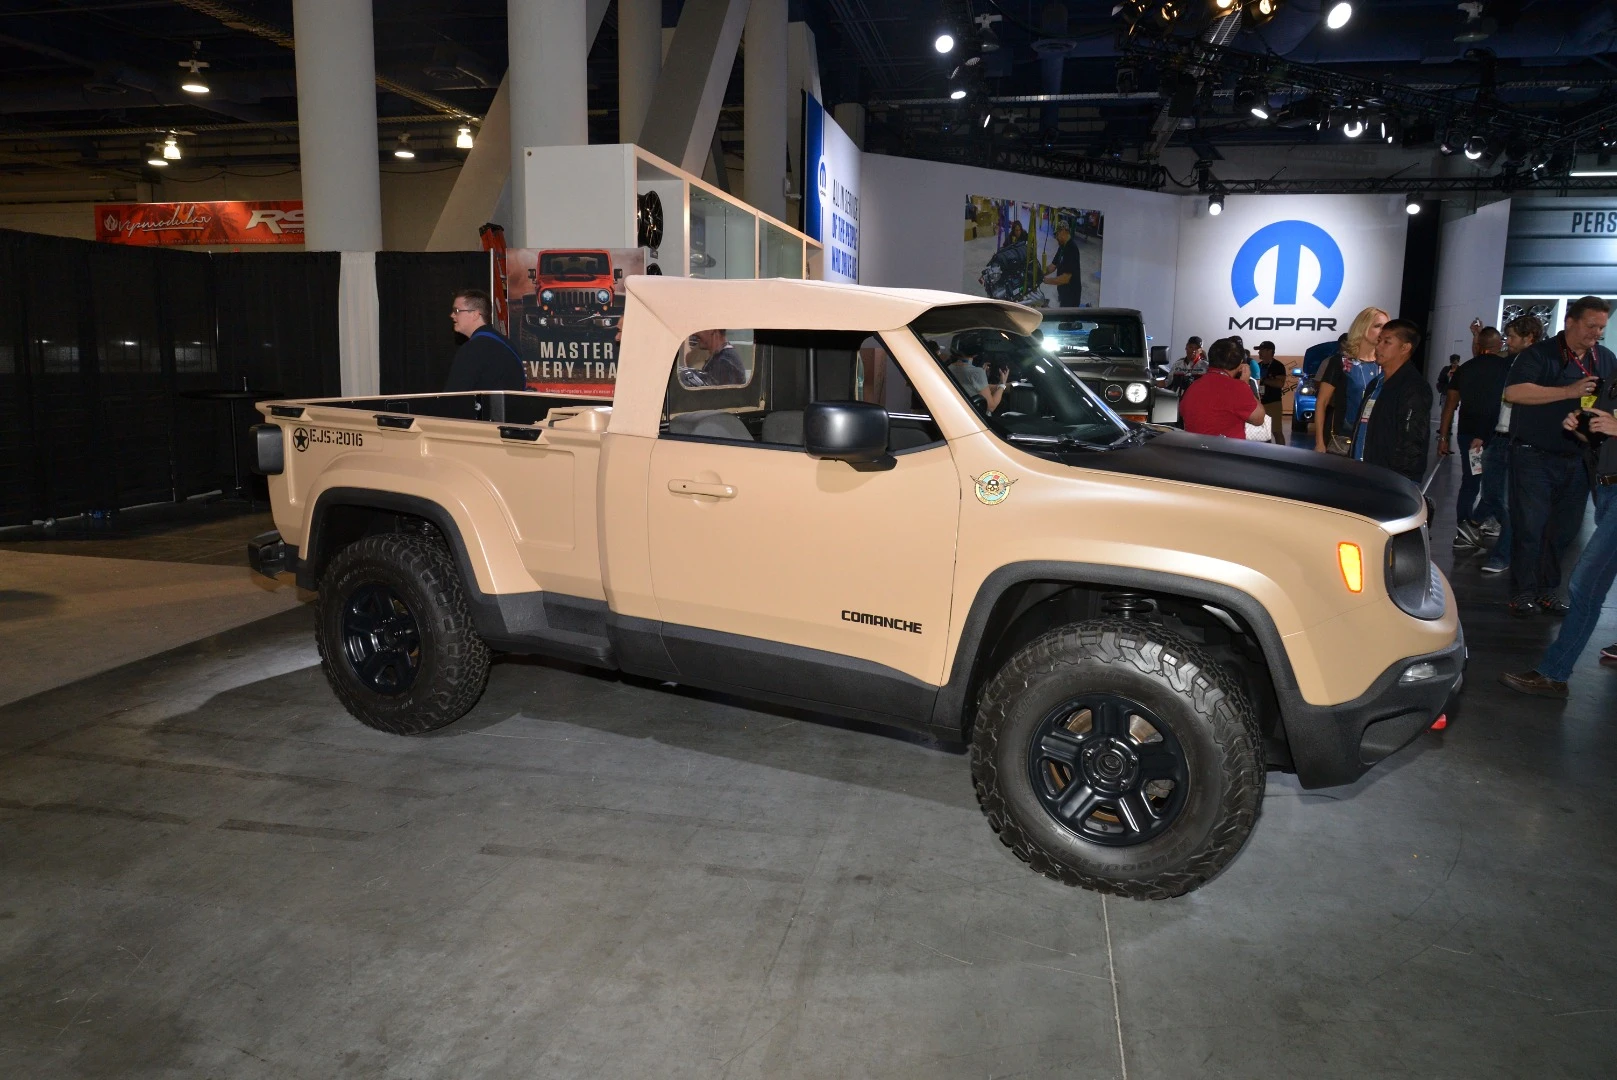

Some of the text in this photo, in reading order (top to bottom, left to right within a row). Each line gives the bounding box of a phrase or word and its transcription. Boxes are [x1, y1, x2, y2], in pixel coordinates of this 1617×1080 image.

[1571, 211, 1617, 233] PERS
[1228, 317, 1338, 331] MOPAR
[540, 341, 614, 359] MASTER
[309, 428, 363, 447] EJS:2016
[841, 609, 923, 635] COMANCHE
